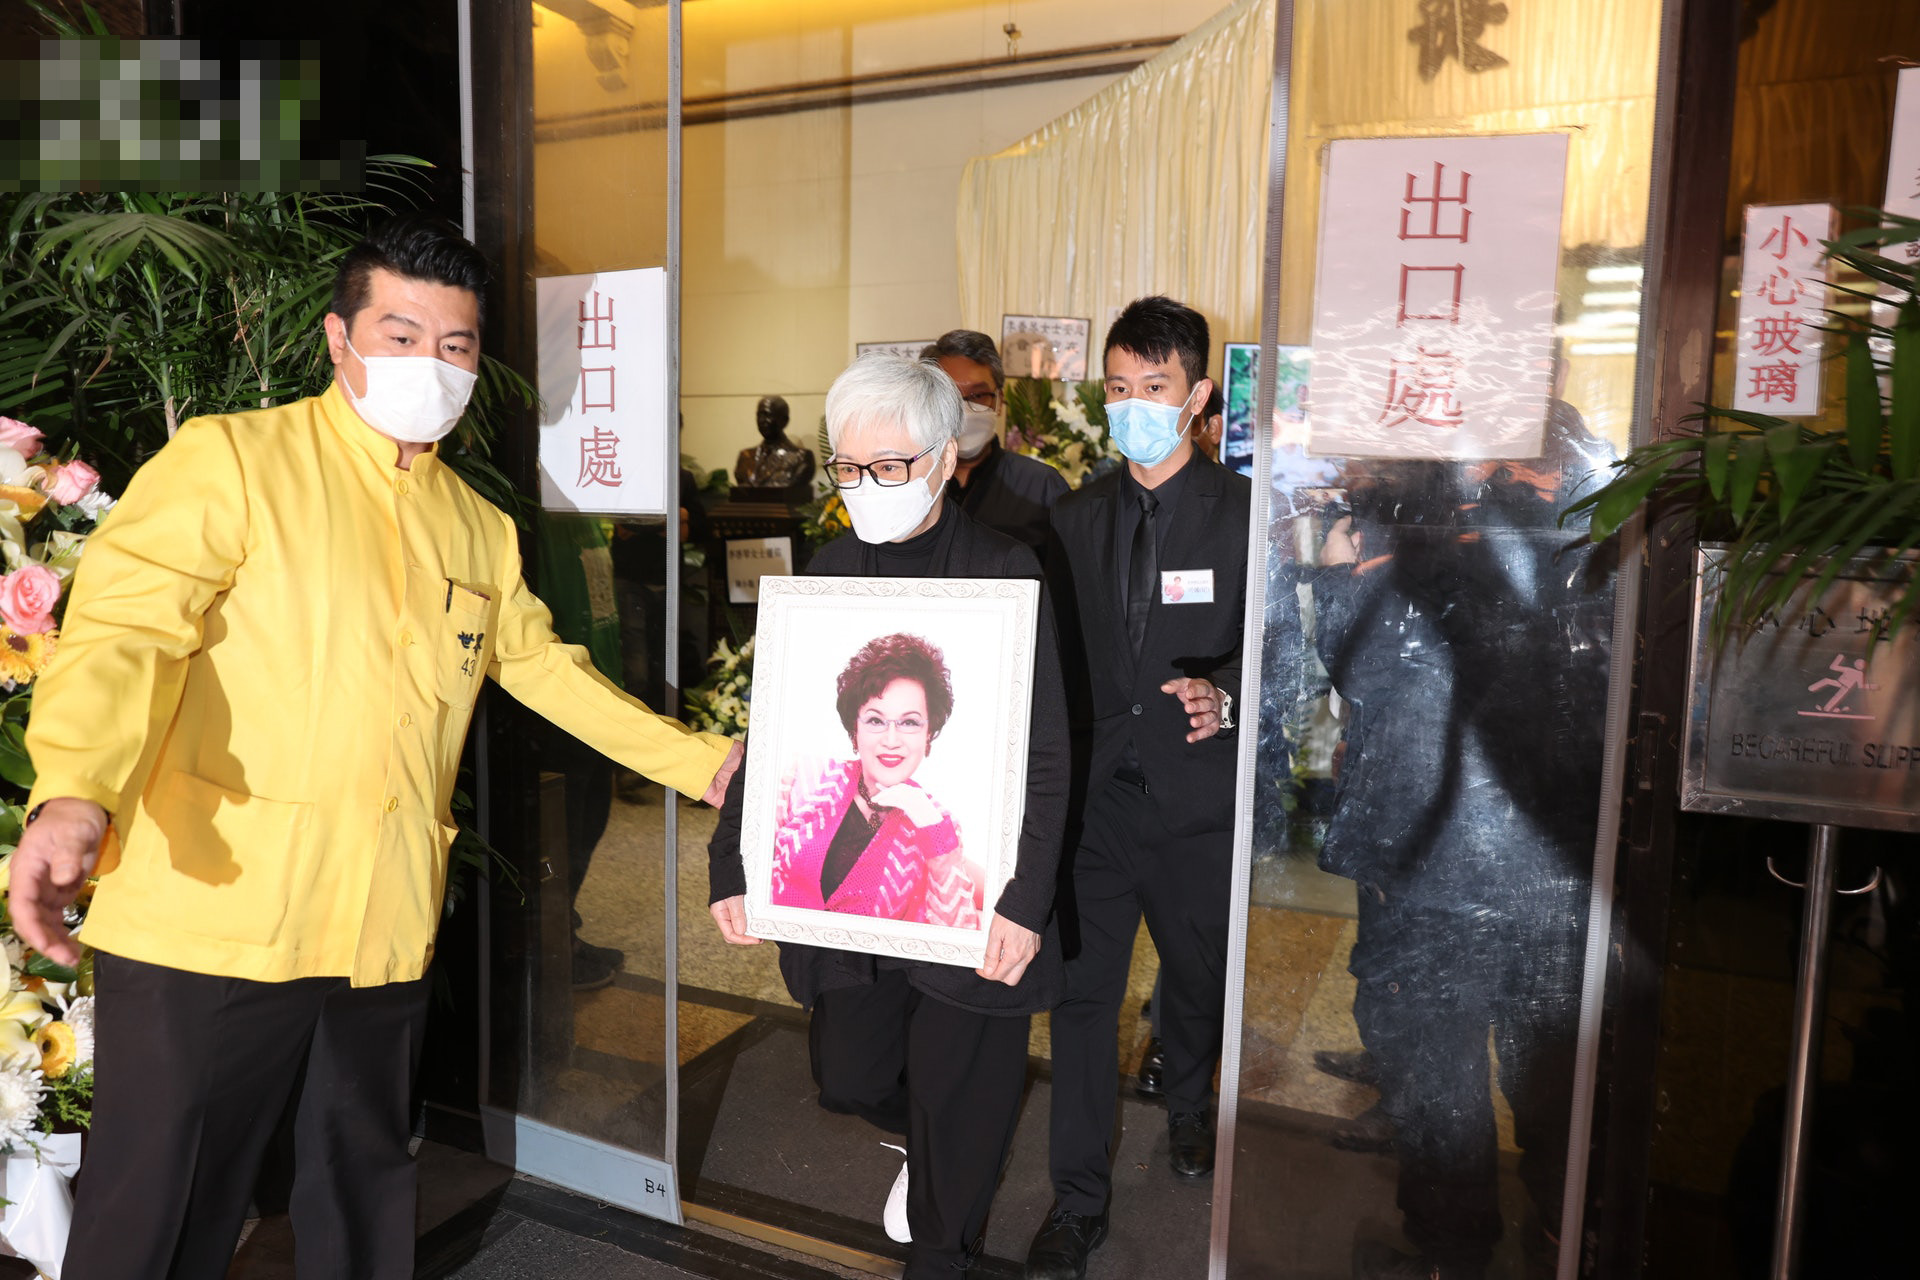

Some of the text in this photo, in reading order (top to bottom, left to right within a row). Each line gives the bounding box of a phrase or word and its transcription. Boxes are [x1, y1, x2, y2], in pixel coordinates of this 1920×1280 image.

[575, 290, 623, 488] 出口處
[1376, 160, 1472, 428] 出口處
[1746, 214, 1809, 404] 小心玻璃
[461, 657, 477, 677] 43
[645, 1178, 666, 1198] B4
